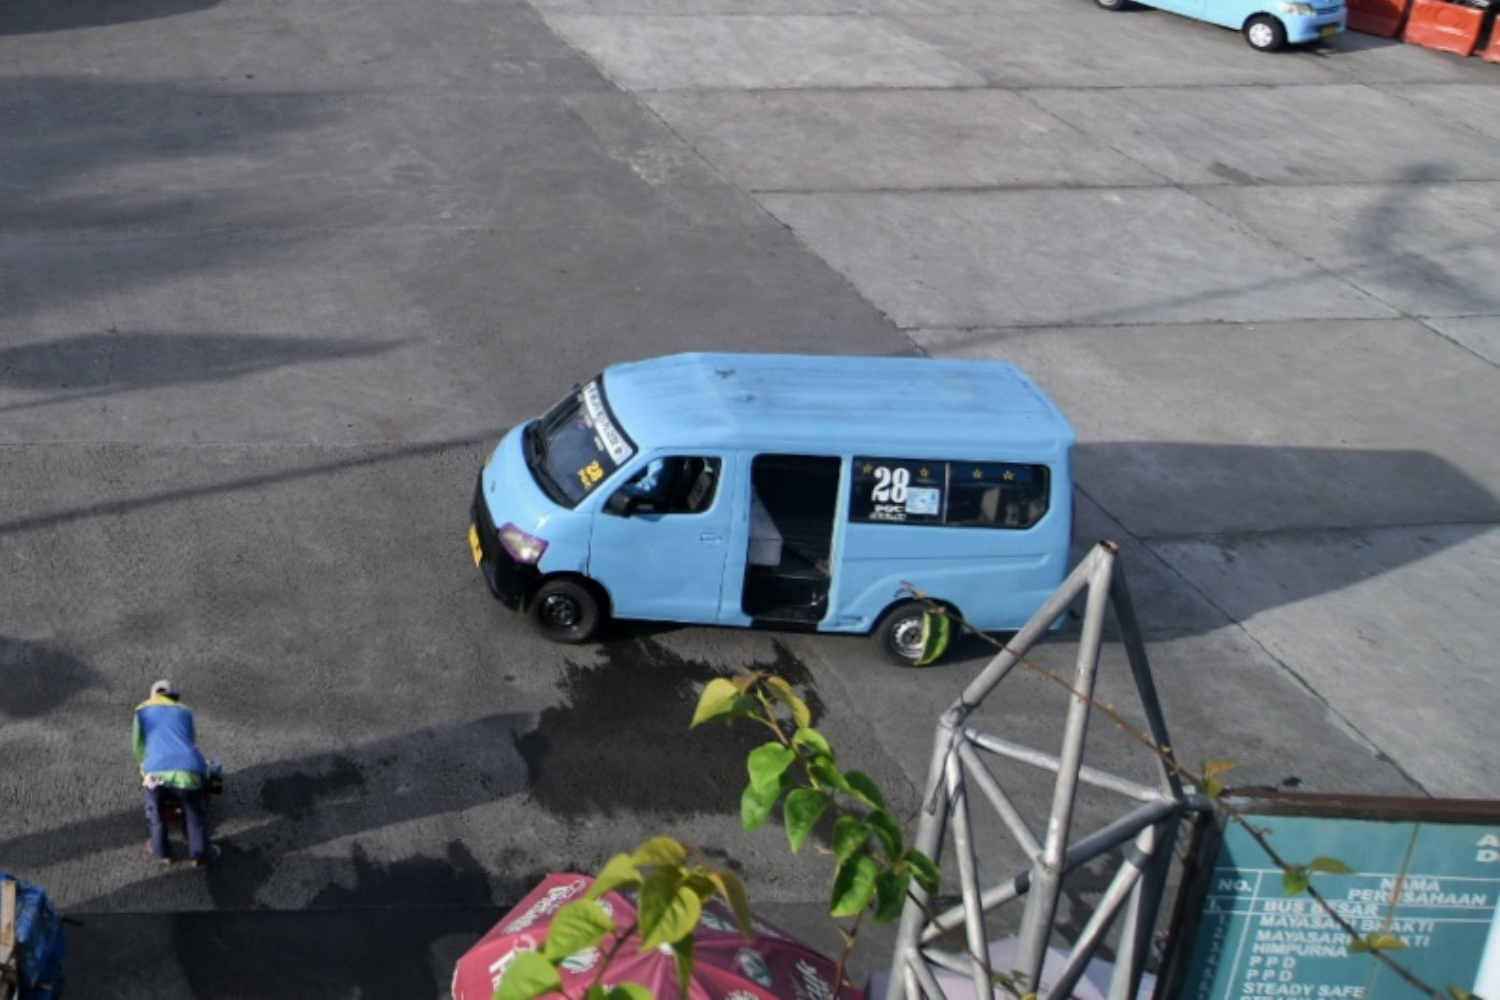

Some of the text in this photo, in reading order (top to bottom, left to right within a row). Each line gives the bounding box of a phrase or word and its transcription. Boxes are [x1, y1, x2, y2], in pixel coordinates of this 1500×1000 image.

[871, 466, 910, 503] 28
[1263, 900, 1306, 913] BUS
[1255, 930, 1353, 945] MAYASARI
[1252, 942, 1349, 957] HIMPURNA
[1243, 982, 1315, 996] STEADY
[1318, 985, 1367, 998] SAFE
